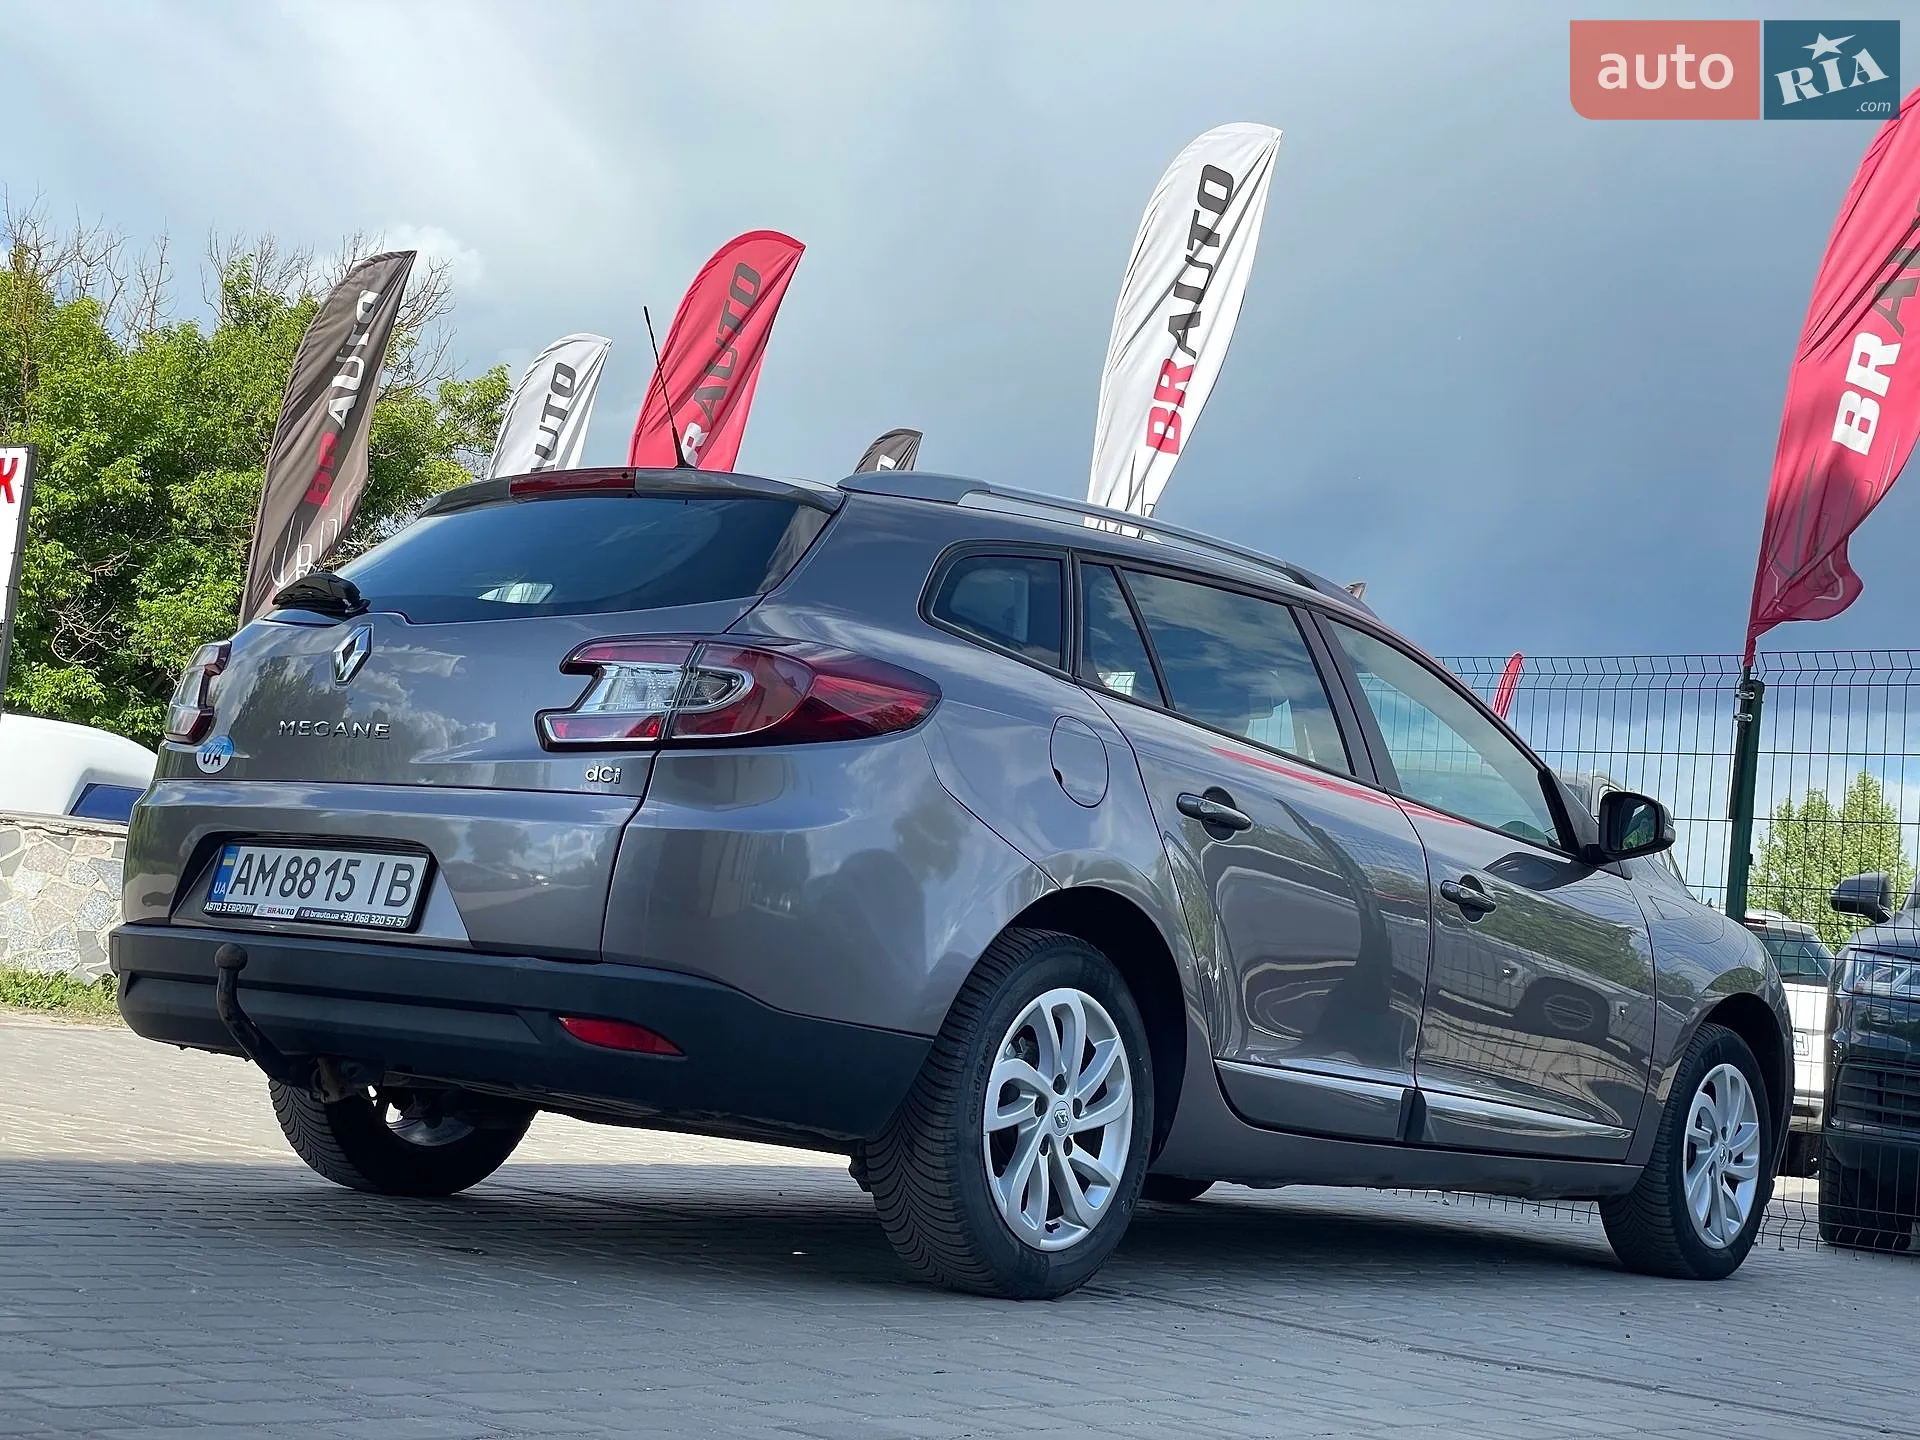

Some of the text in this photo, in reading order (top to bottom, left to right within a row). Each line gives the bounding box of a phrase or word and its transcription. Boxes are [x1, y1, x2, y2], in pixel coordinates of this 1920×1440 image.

[1145, 163, 1234, 455] BRAUTO
[531, 362, 577, 472] UTO
[278, 720, 390, 739] MEGANE
[202, 743, 226, 766] UA
[585, 766, 621, 784] dCi
[213, 881, 227, 895] UA
[204, 902, 222, 912] АВТО
[267, 907, 295, 916] BRAUTO
